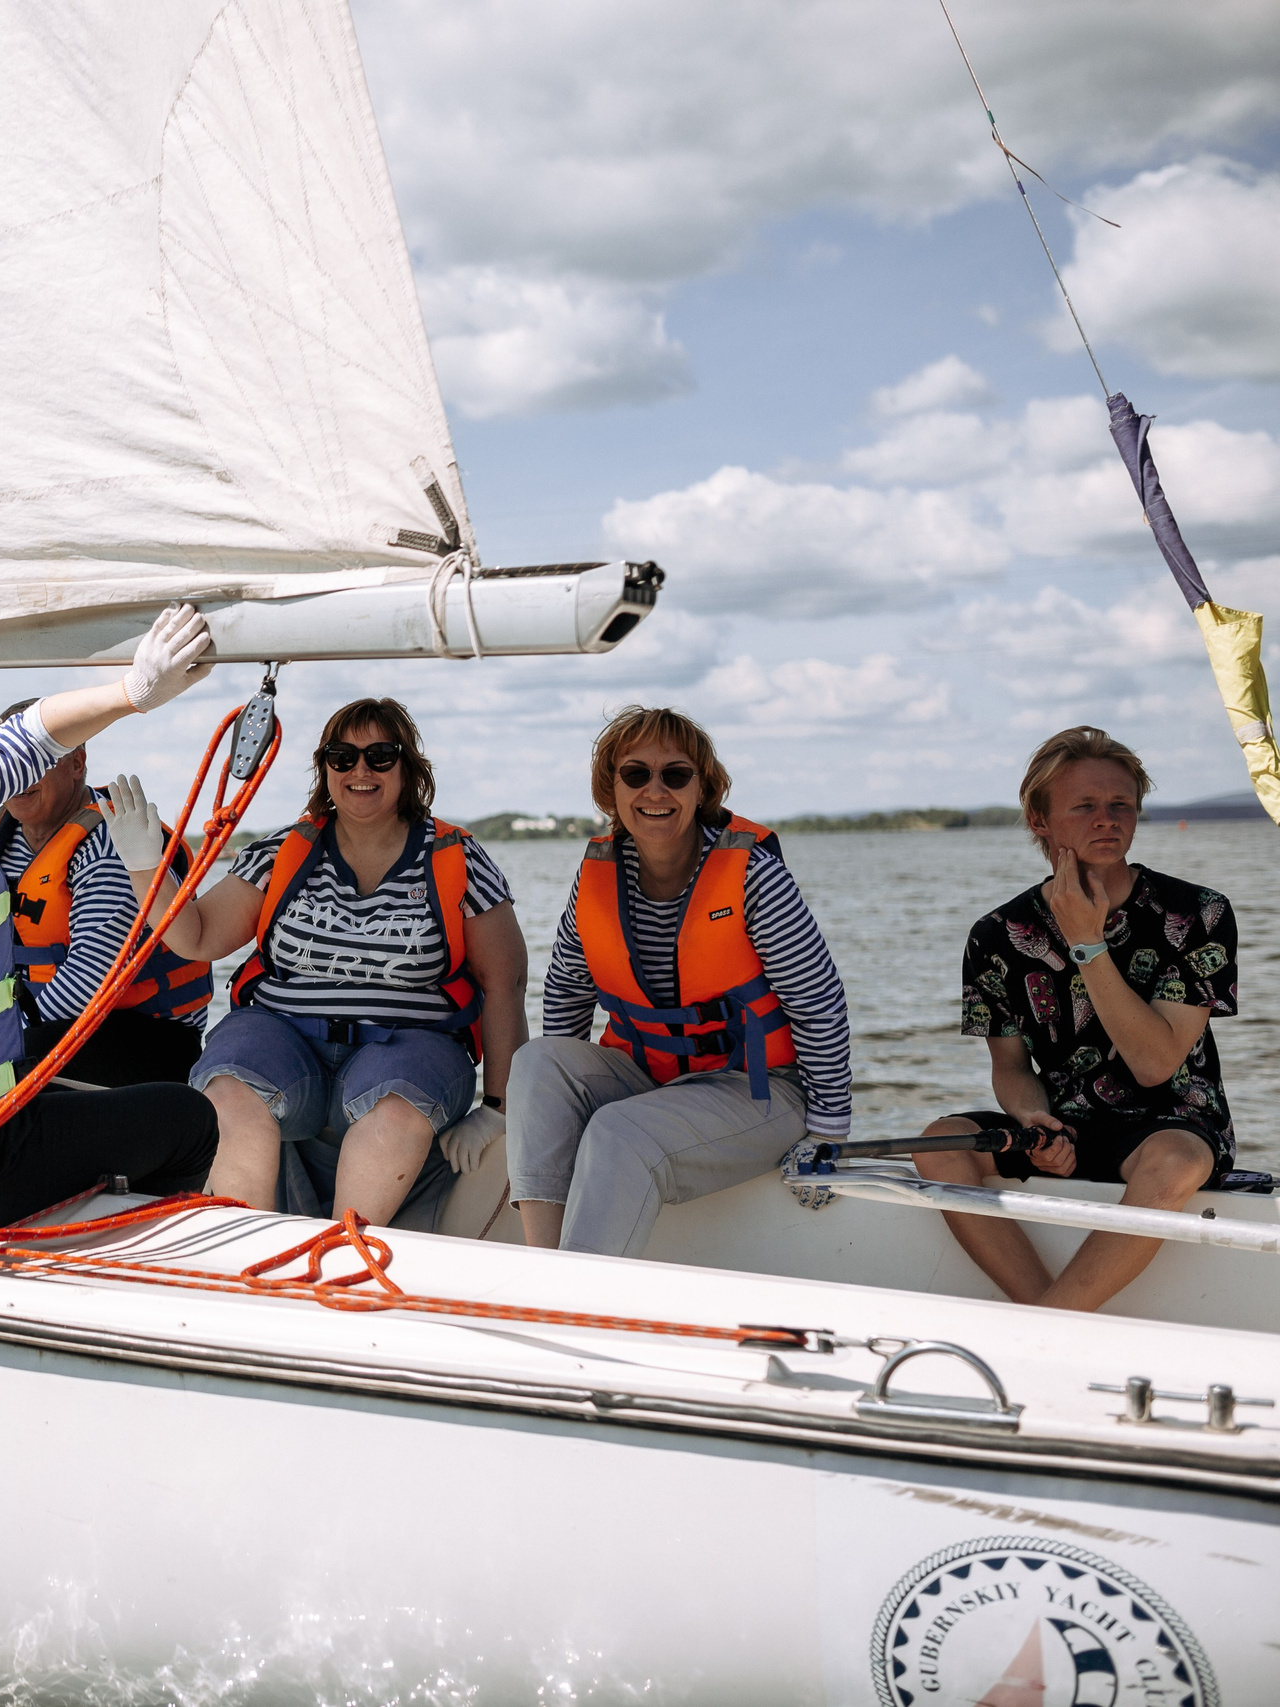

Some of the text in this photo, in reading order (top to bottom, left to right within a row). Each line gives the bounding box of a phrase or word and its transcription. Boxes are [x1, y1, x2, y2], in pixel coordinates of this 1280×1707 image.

[919, 1582, 1167, 1706] GUBERNSKIY YACHT CLU
